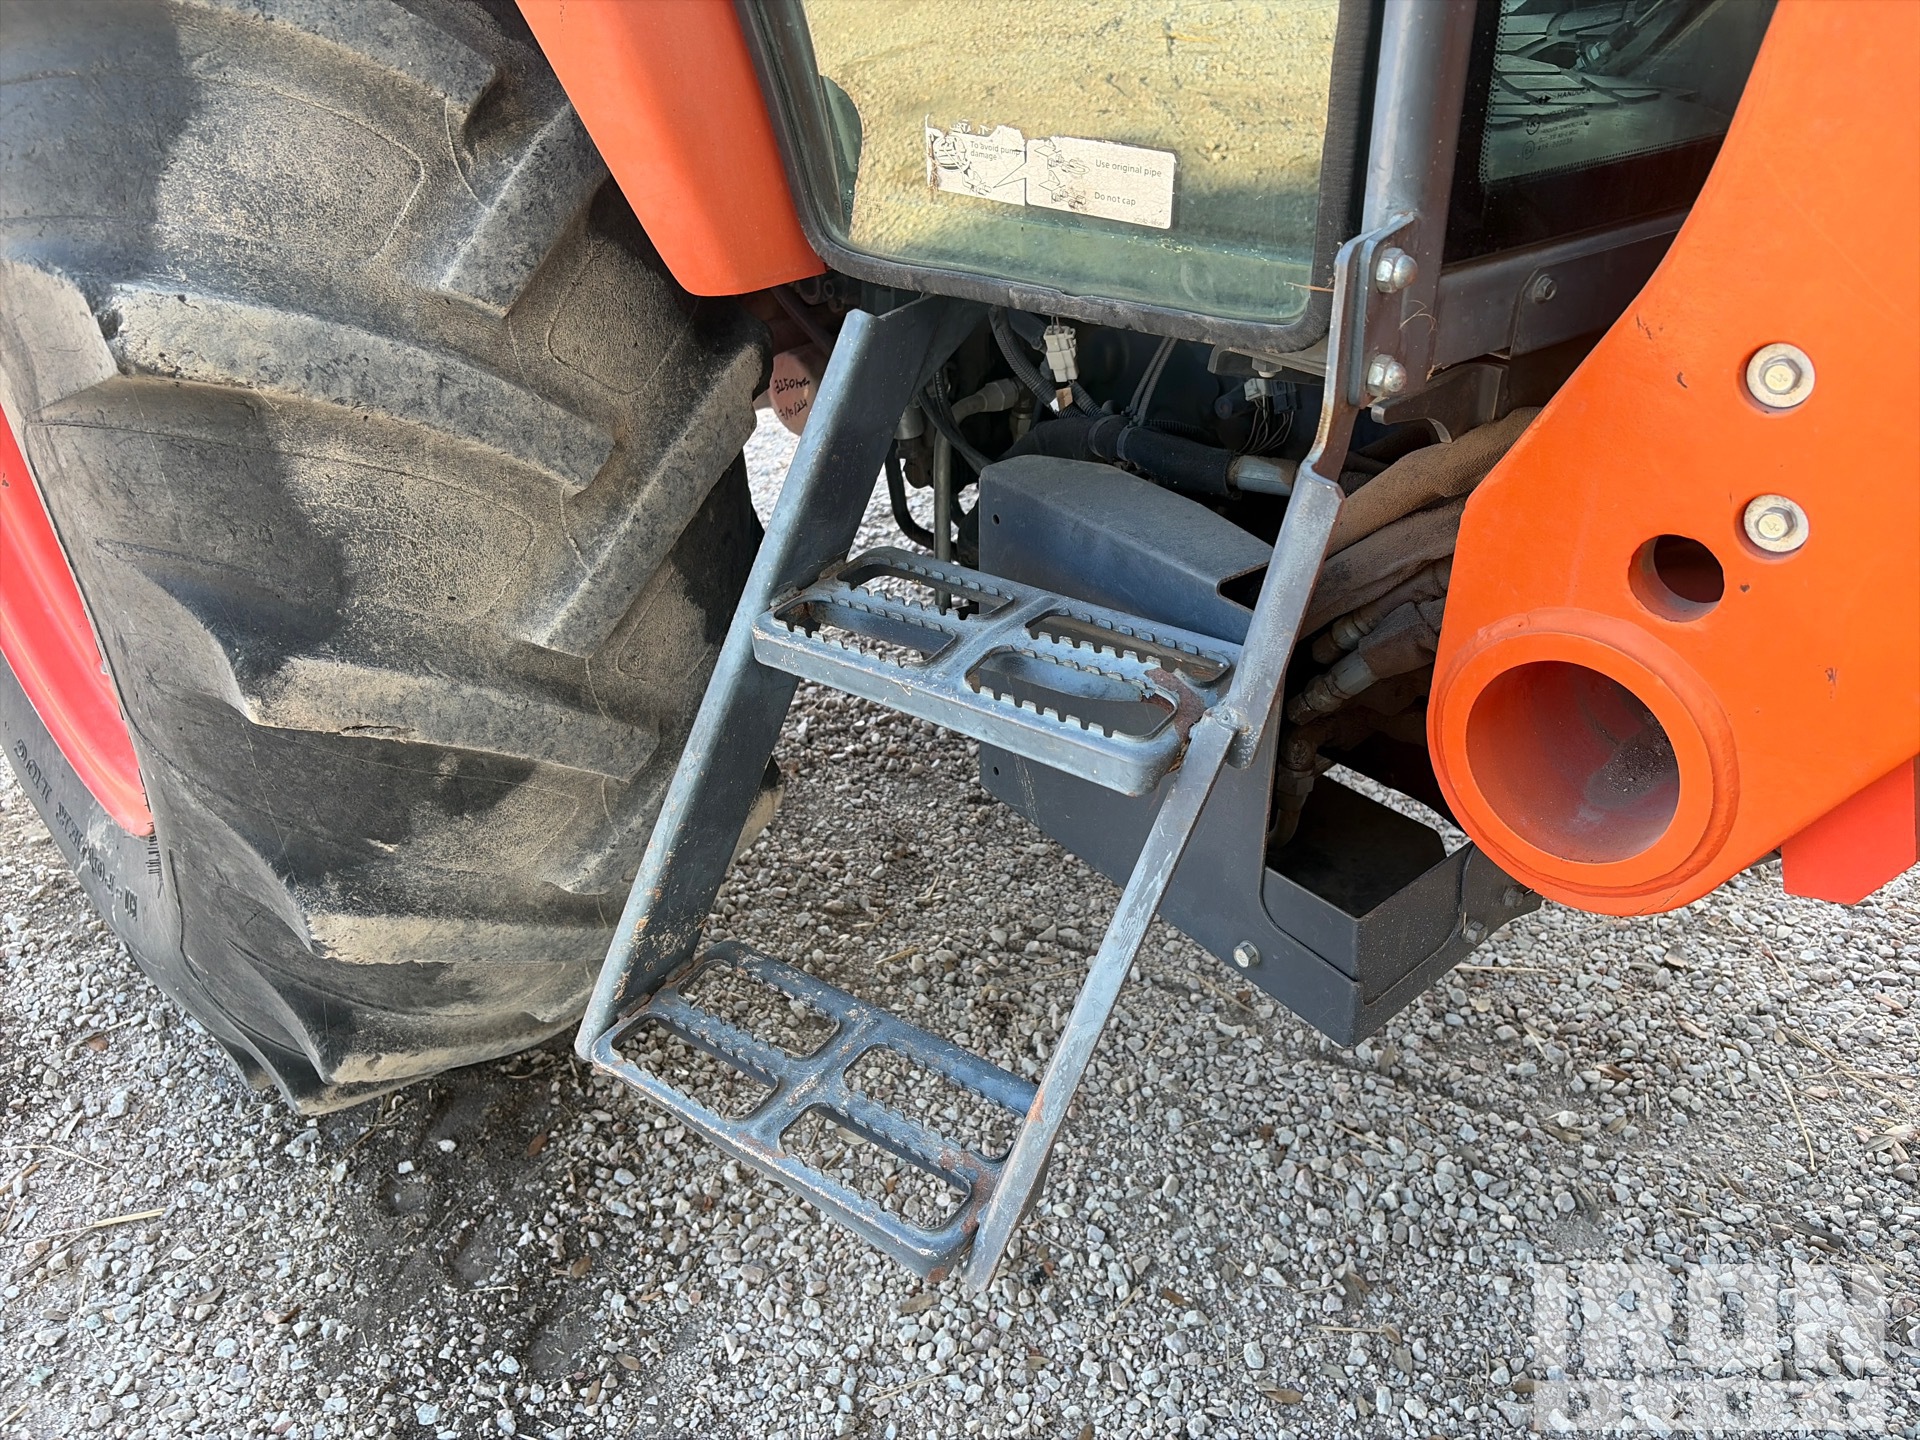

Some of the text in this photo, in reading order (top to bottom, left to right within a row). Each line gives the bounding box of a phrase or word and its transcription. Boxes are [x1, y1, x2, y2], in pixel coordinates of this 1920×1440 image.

[970, 140, 979, 149] To
[980, 143, 999, 153] avoid
[970, 149, 998, 161] damage
[1095, 159, 1162, 178] Use original pipe
[1094, 191, 1136, 207] Do not cap
[13, 738, 53, 804] LUG
